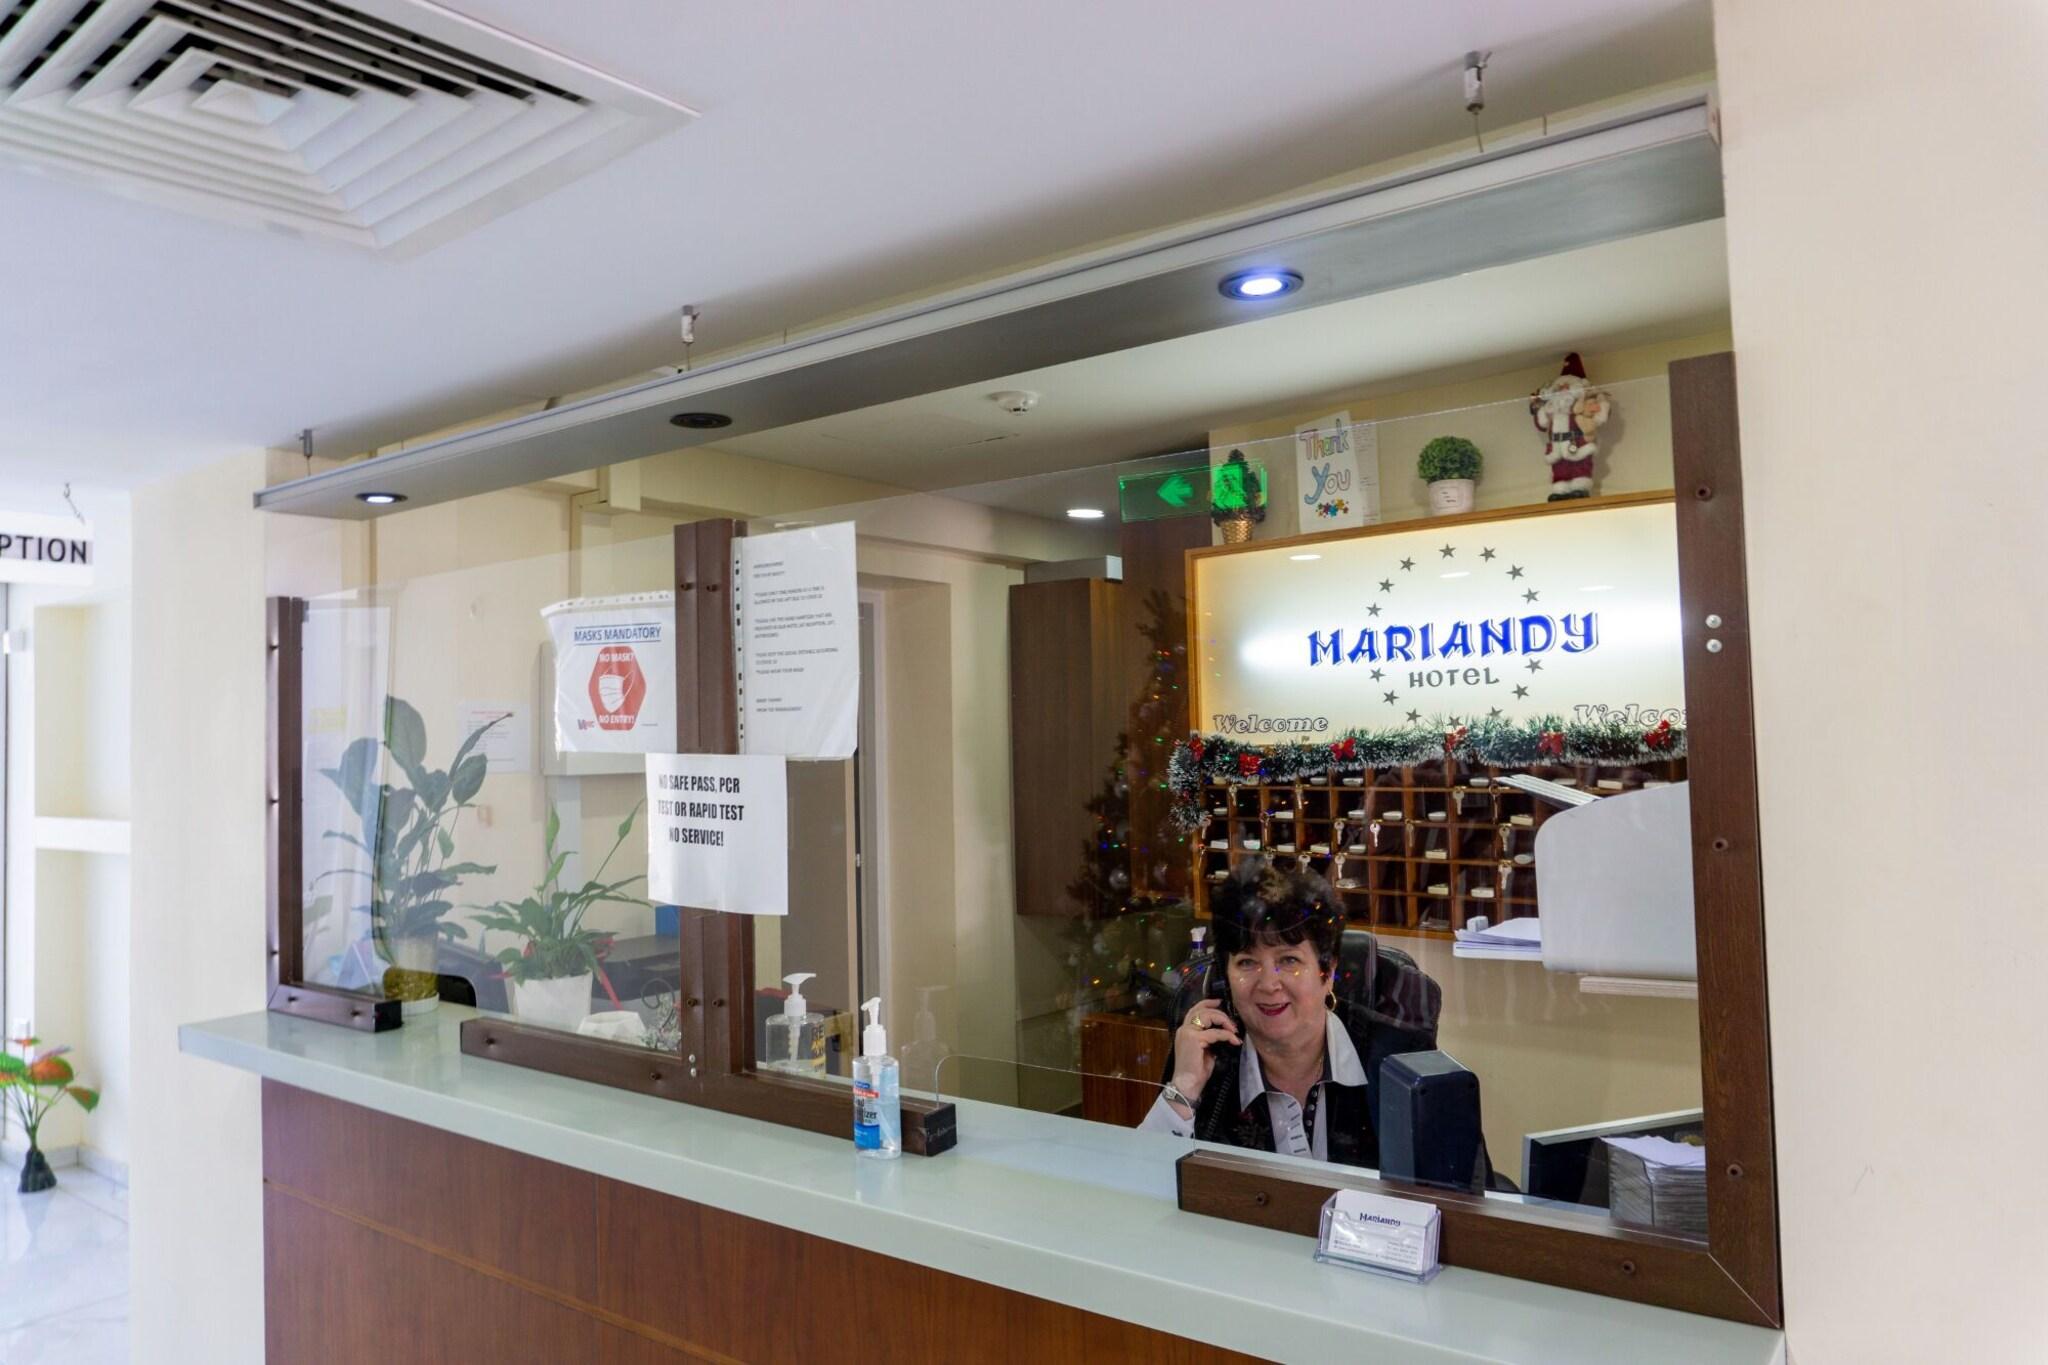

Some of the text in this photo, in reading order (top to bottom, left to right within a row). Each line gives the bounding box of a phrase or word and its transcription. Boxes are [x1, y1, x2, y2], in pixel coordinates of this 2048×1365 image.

[574, 627, 661, 641] MASKS MANDATORY
[1308, 611, 1600, 667] MARIANDY
[600, 653, 610, 662] NO
[600, 715, 610, 723] NO
[1213, 714, 1328, 734] Welcome
[1574, 704, 1687, 726] Welco
[659, 774, 668, 789] NO
[669, 775, 689, 791] SAFE
[719, 777, 740, 793] PCR
[658, 800, 744, 820] TEST OR RAPID TEST
[669, 827, 724, 846] NO SERVICE!
